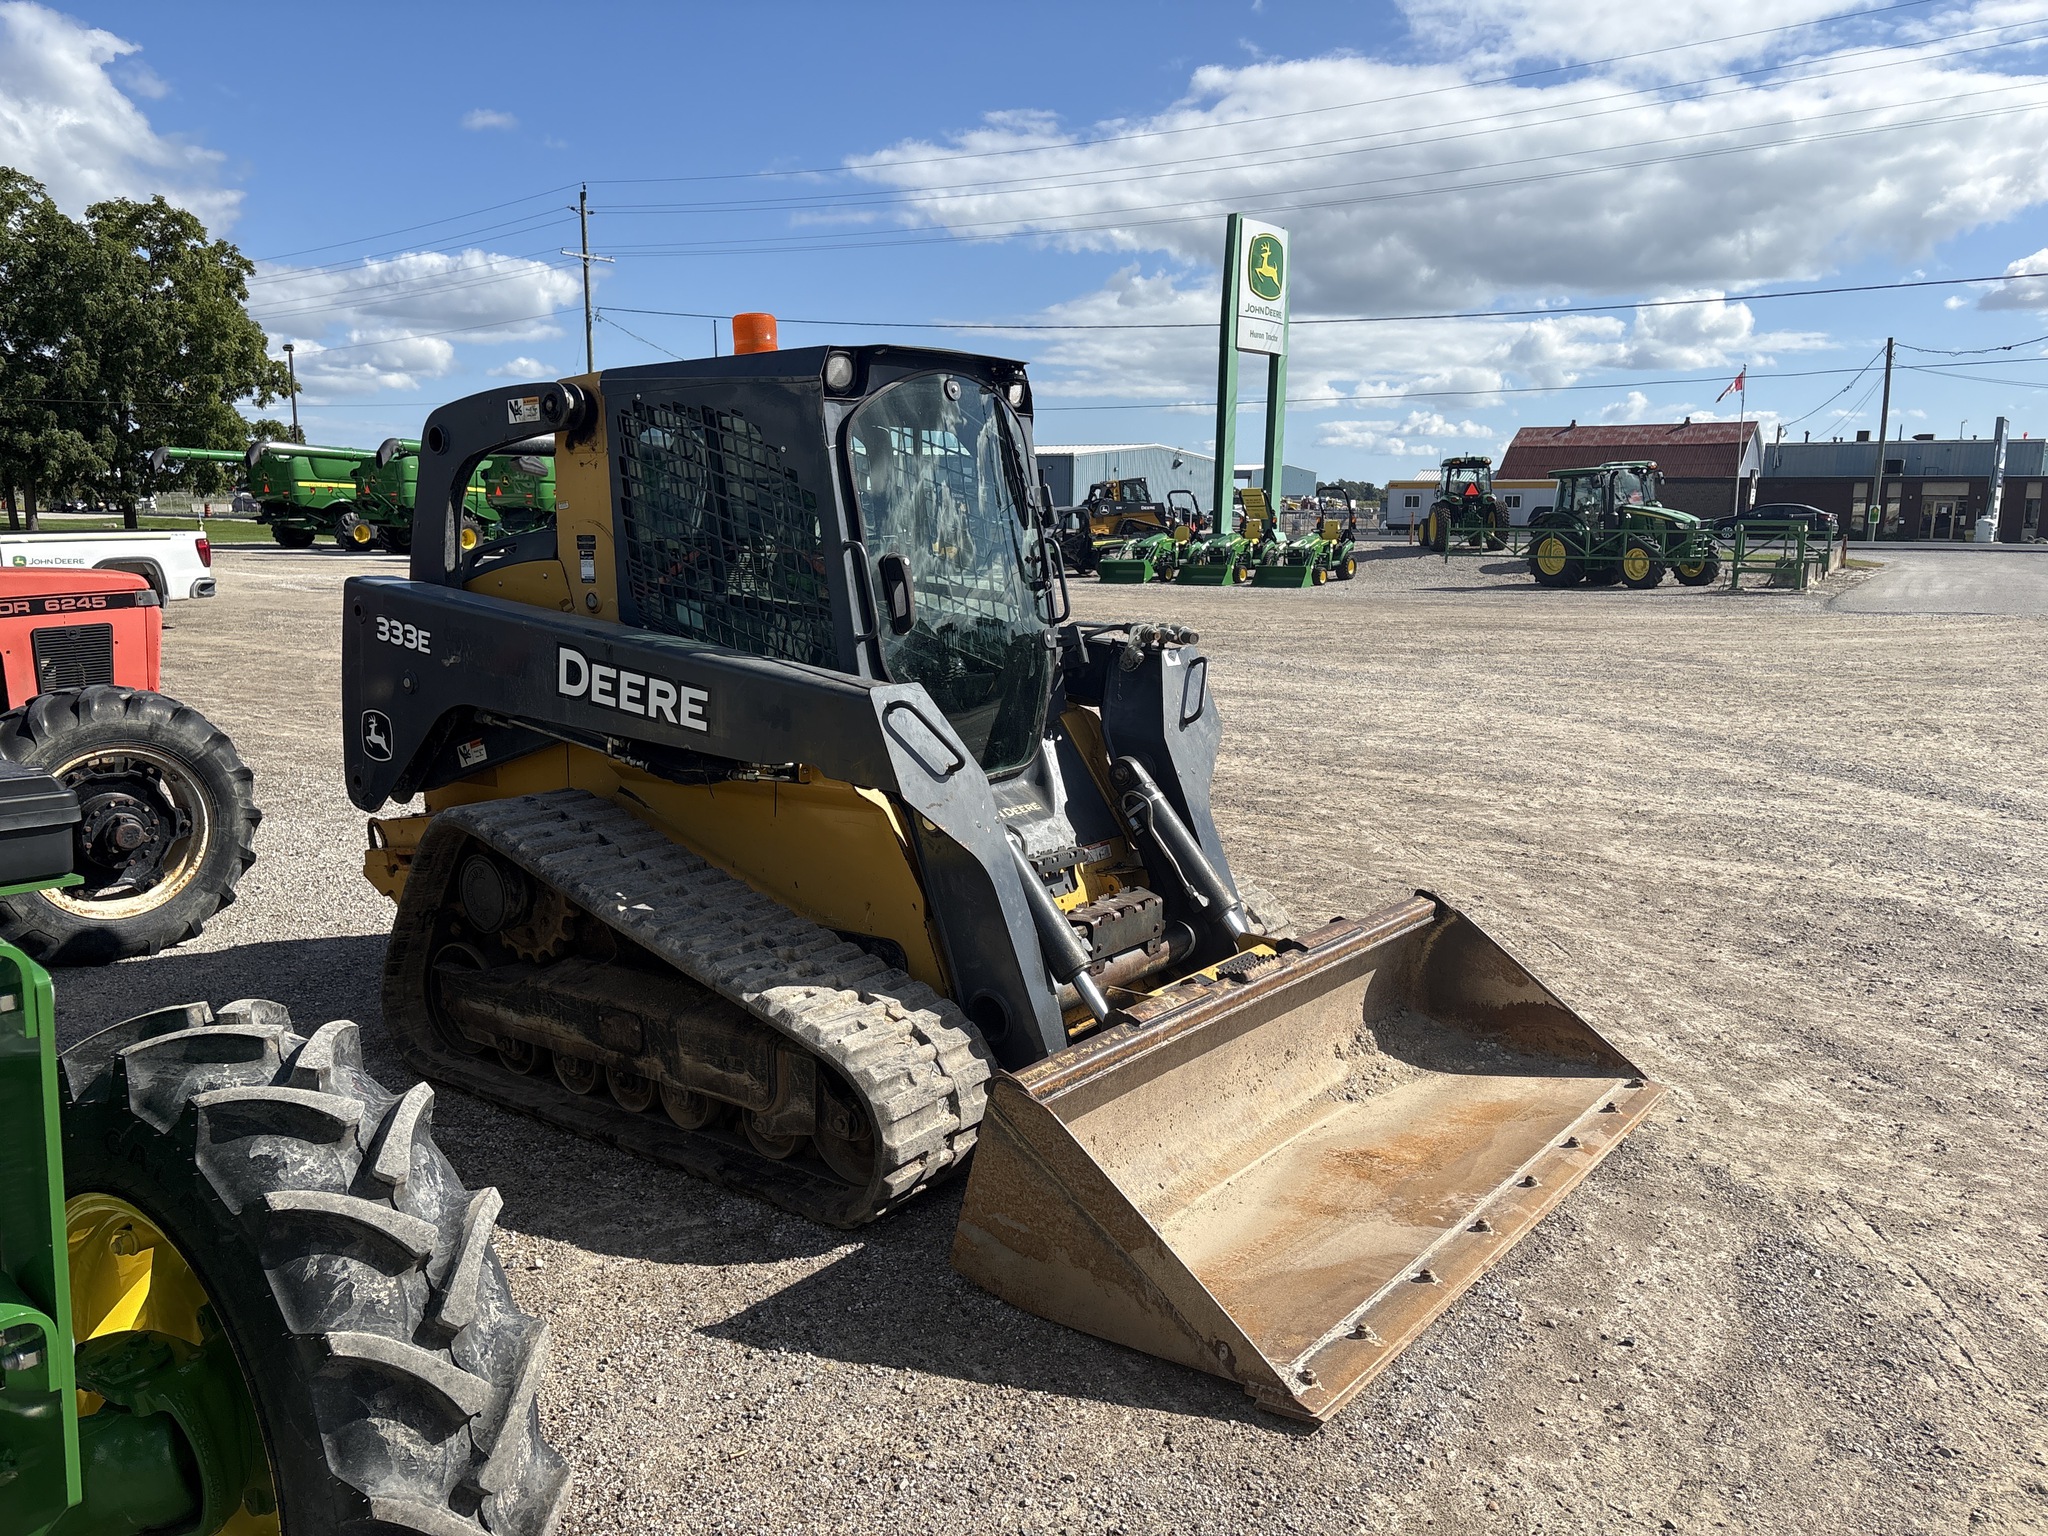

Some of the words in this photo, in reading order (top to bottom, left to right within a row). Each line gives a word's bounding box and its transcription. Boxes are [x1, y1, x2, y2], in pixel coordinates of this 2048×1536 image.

[1245, 303, 1265, 315] JOHN
[1265, 306, 1282, 319] DEERE
[1249, 330, 1265, 339] Huron
[1266, 332, 1278, 342] Tractor
[29, 557, 53, 565] JOHN
[55, 557, 85, 565] DEERE
[44, 596, 107, 612] 6245
[375, 616, 431, 654] 333E
[558, 647, 709, 732] DEERE
[1002, 802, 1043, 817] DEERE
